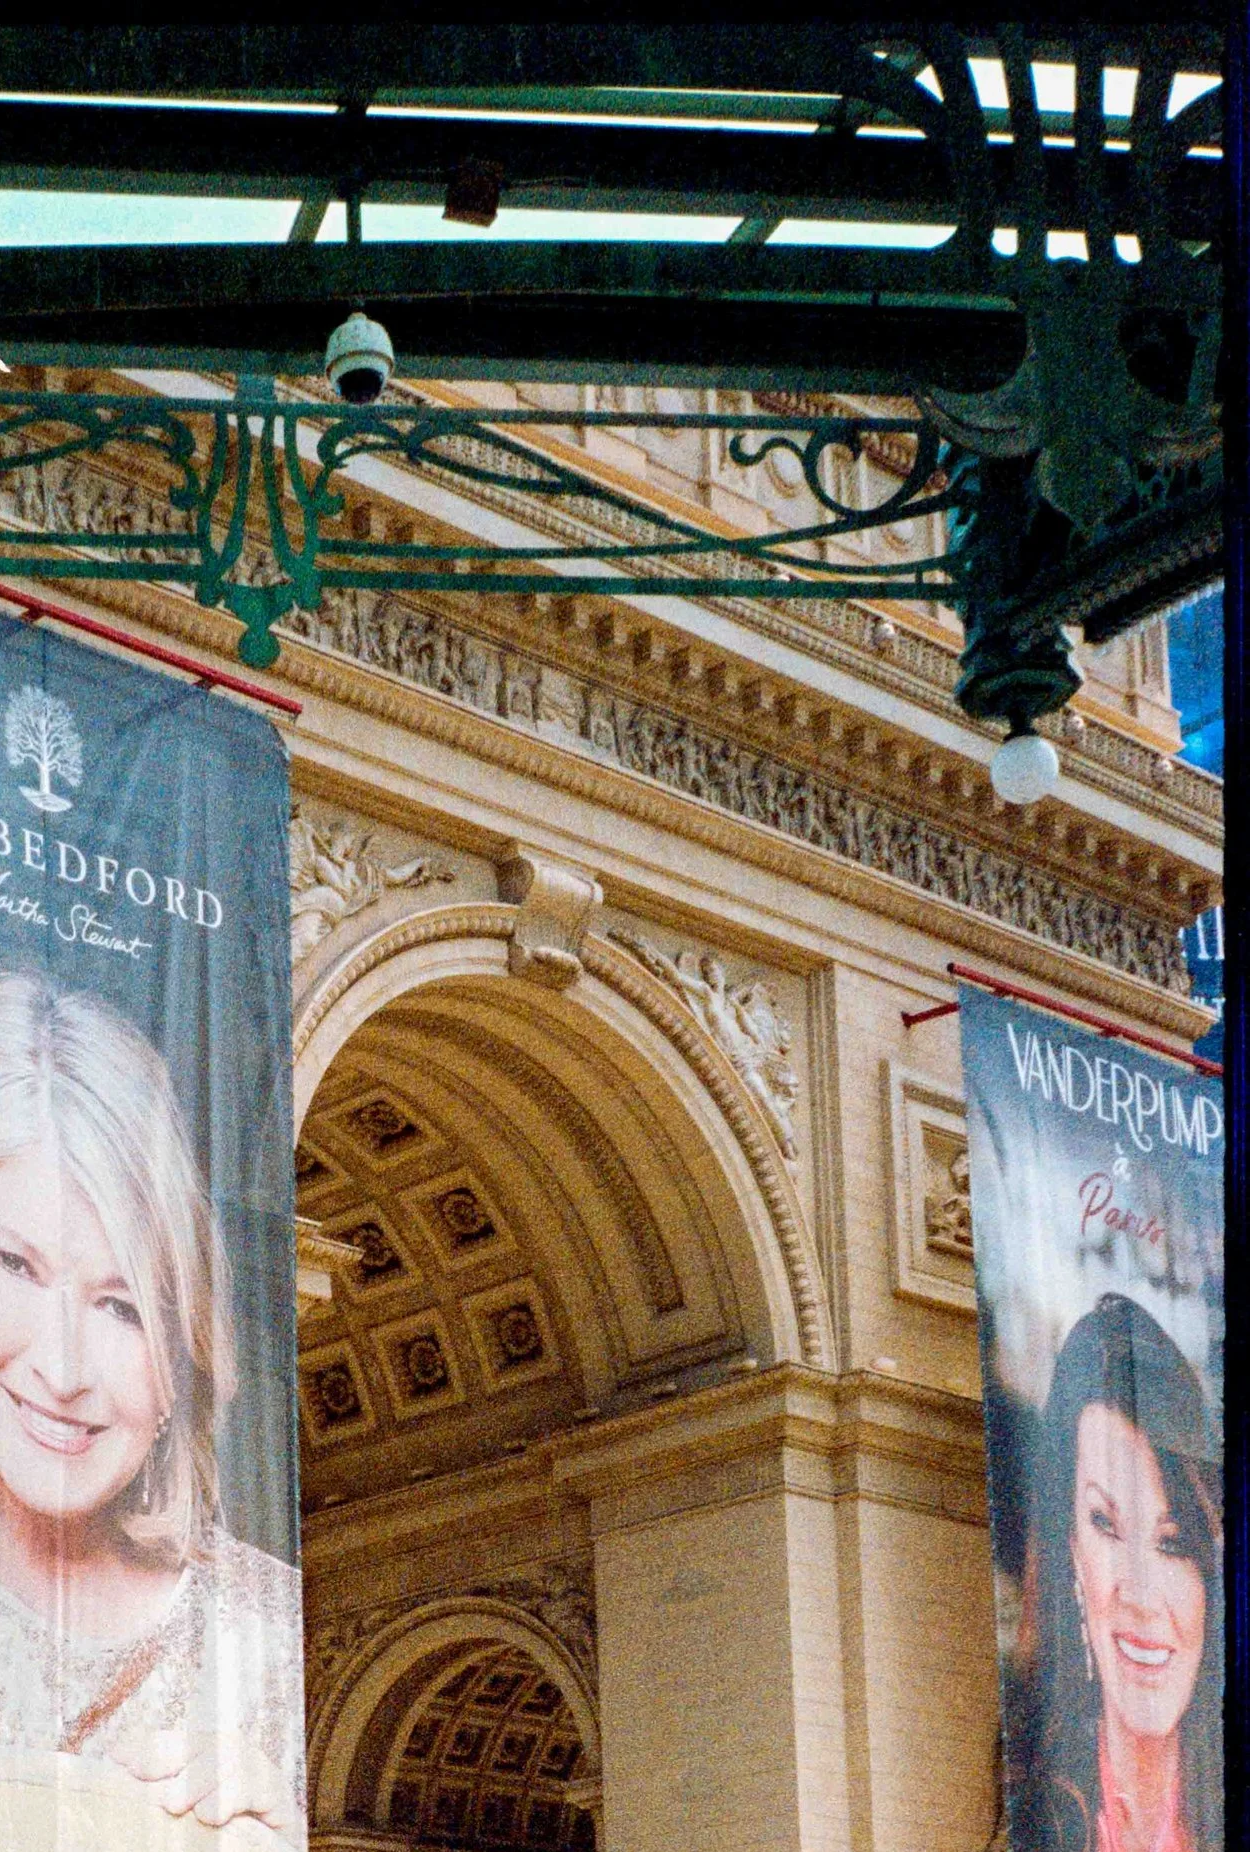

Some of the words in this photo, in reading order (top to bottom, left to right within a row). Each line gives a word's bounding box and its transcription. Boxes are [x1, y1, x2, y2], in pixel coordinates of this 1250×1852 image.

[53, 903, 153, 960] Stewart
[1006, 1022, 1224, 1156] VANDERPUMP
[1078, 1171, 1166, 1244] Paris
